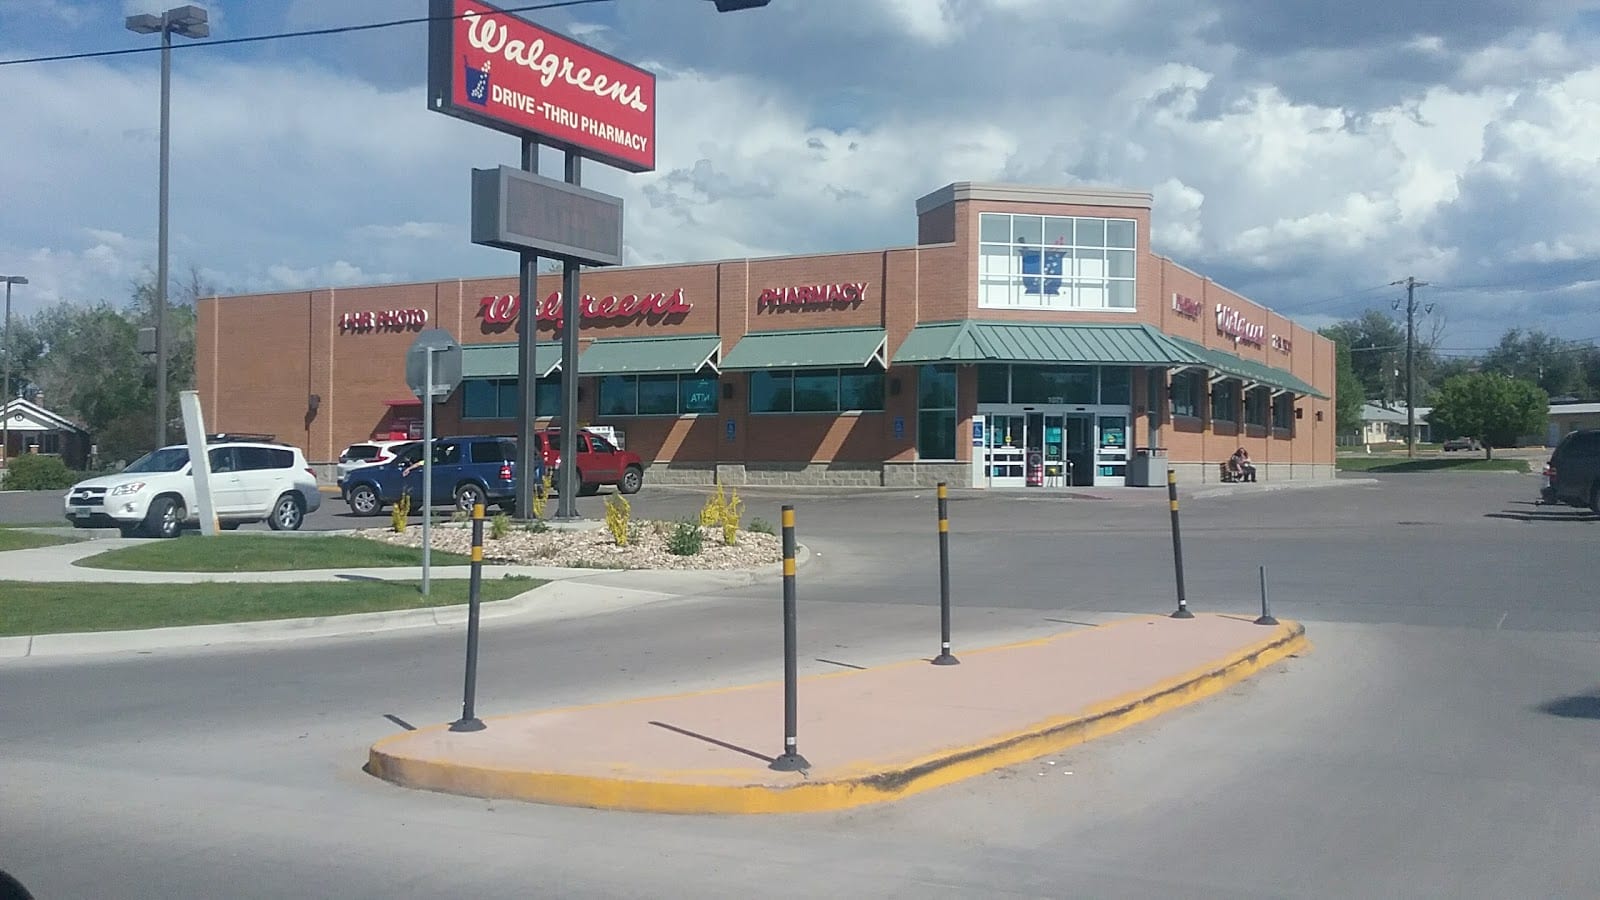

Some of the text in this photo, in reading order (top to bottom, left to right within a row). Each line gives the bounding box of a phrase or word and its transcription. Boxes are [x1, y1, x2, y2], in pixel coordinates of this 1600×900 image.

[462, 10, 648, 112] Walgreens
[581, 116, 648, 152] PHARMACY
[761, 282, 870, 306] PHARMACY
[377, 308, 429, 326] PHOTO
